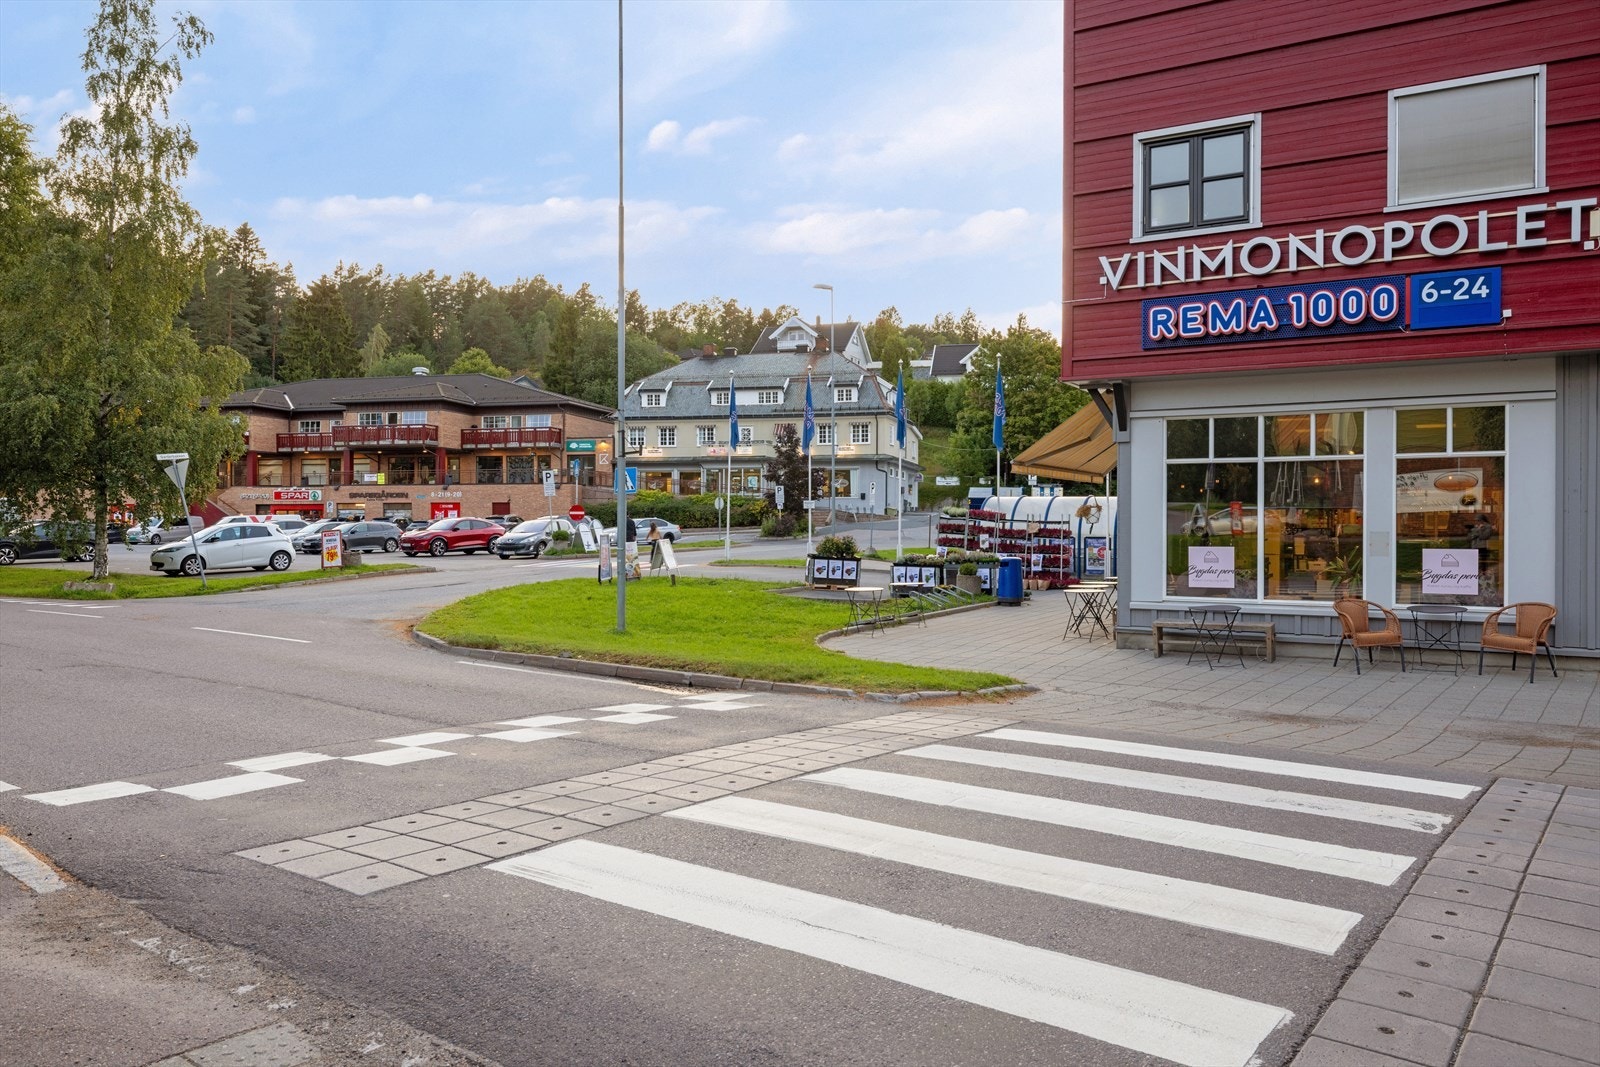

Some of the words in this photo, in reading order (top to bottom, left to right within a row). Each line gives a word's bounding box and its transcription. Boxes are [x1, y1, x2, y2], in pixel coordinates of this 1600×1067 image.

[1098, 197, 1597, 291] VINMONOPOLET
[1149, 296, 1278, 340] REMA
[1287, 284, 1399, 328] 1000
[1421, 276, 1490, 303] 6-24
